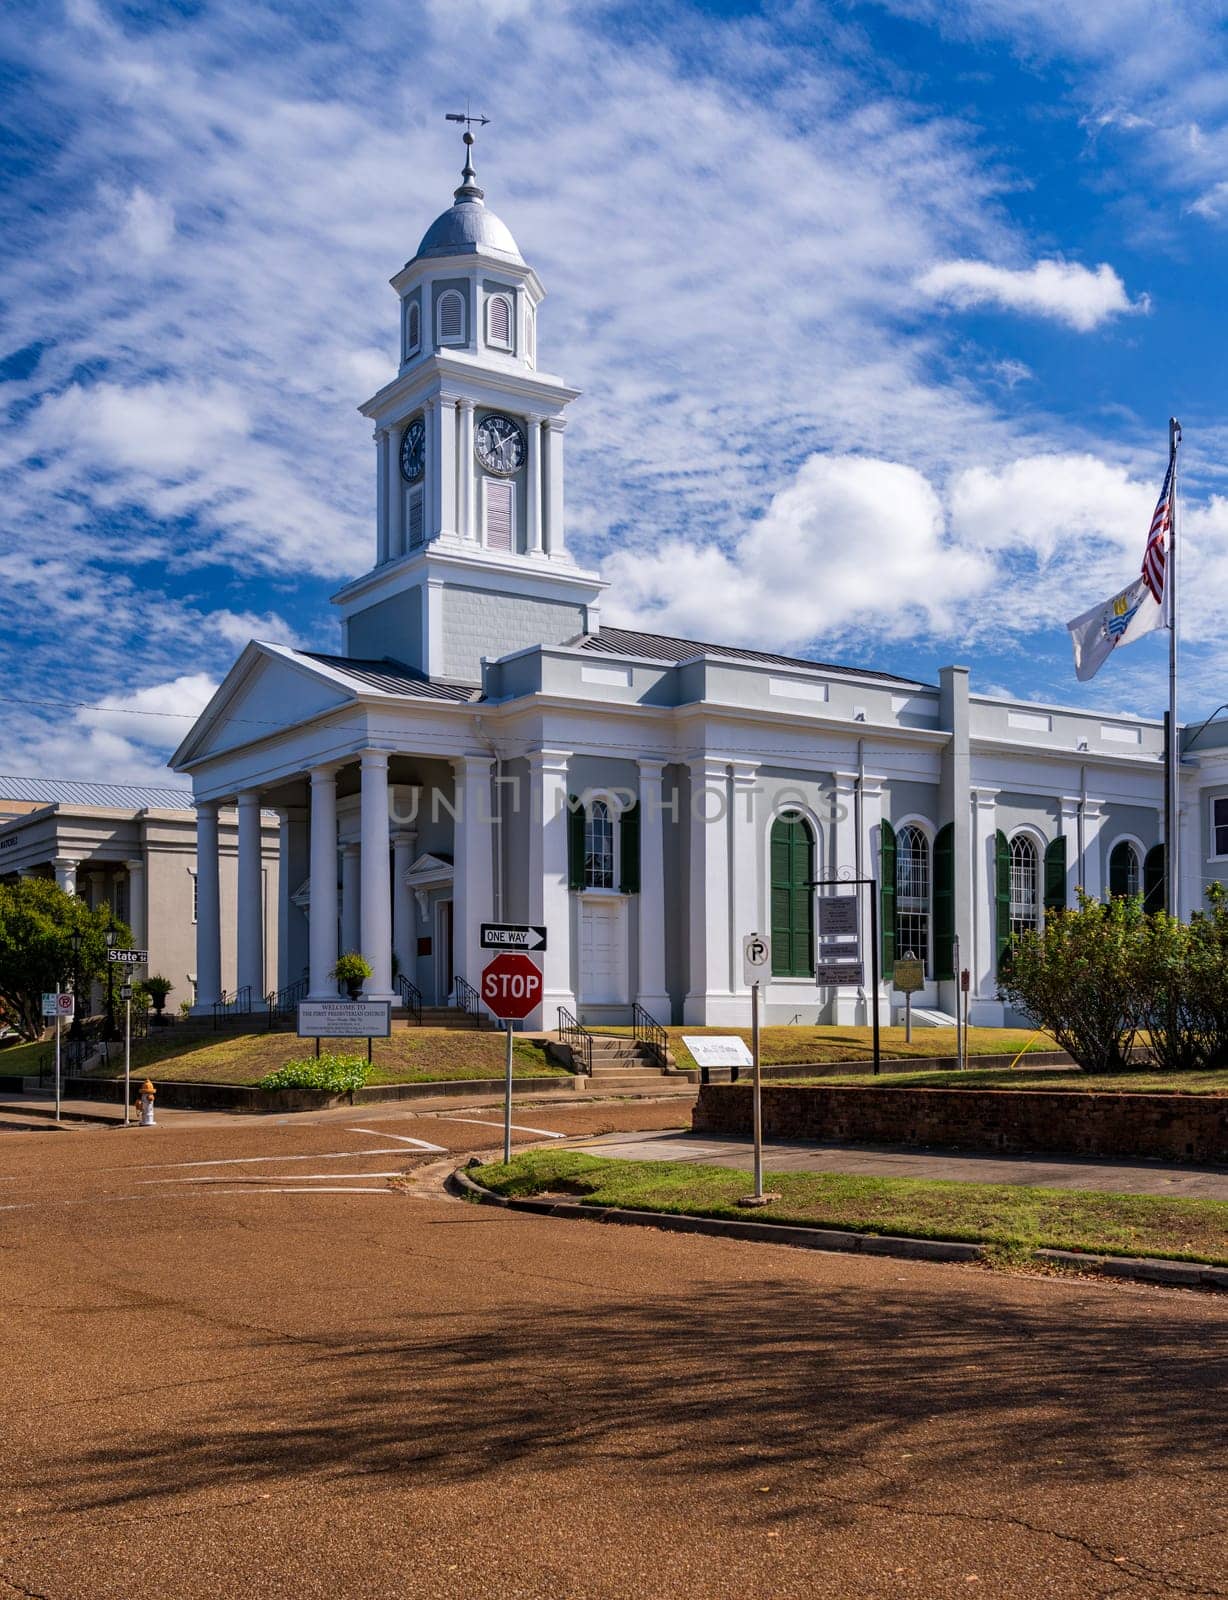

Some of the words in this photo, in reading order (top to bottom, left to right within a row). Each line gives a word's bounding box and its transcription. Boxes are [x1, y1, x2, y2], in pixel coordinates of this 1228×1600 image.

[487, 931, 505, 942] ONE
[508, 932, 526, 942] WAY
[109, 950, 138, 961] State
[485, 973, 539, 998] STOP
